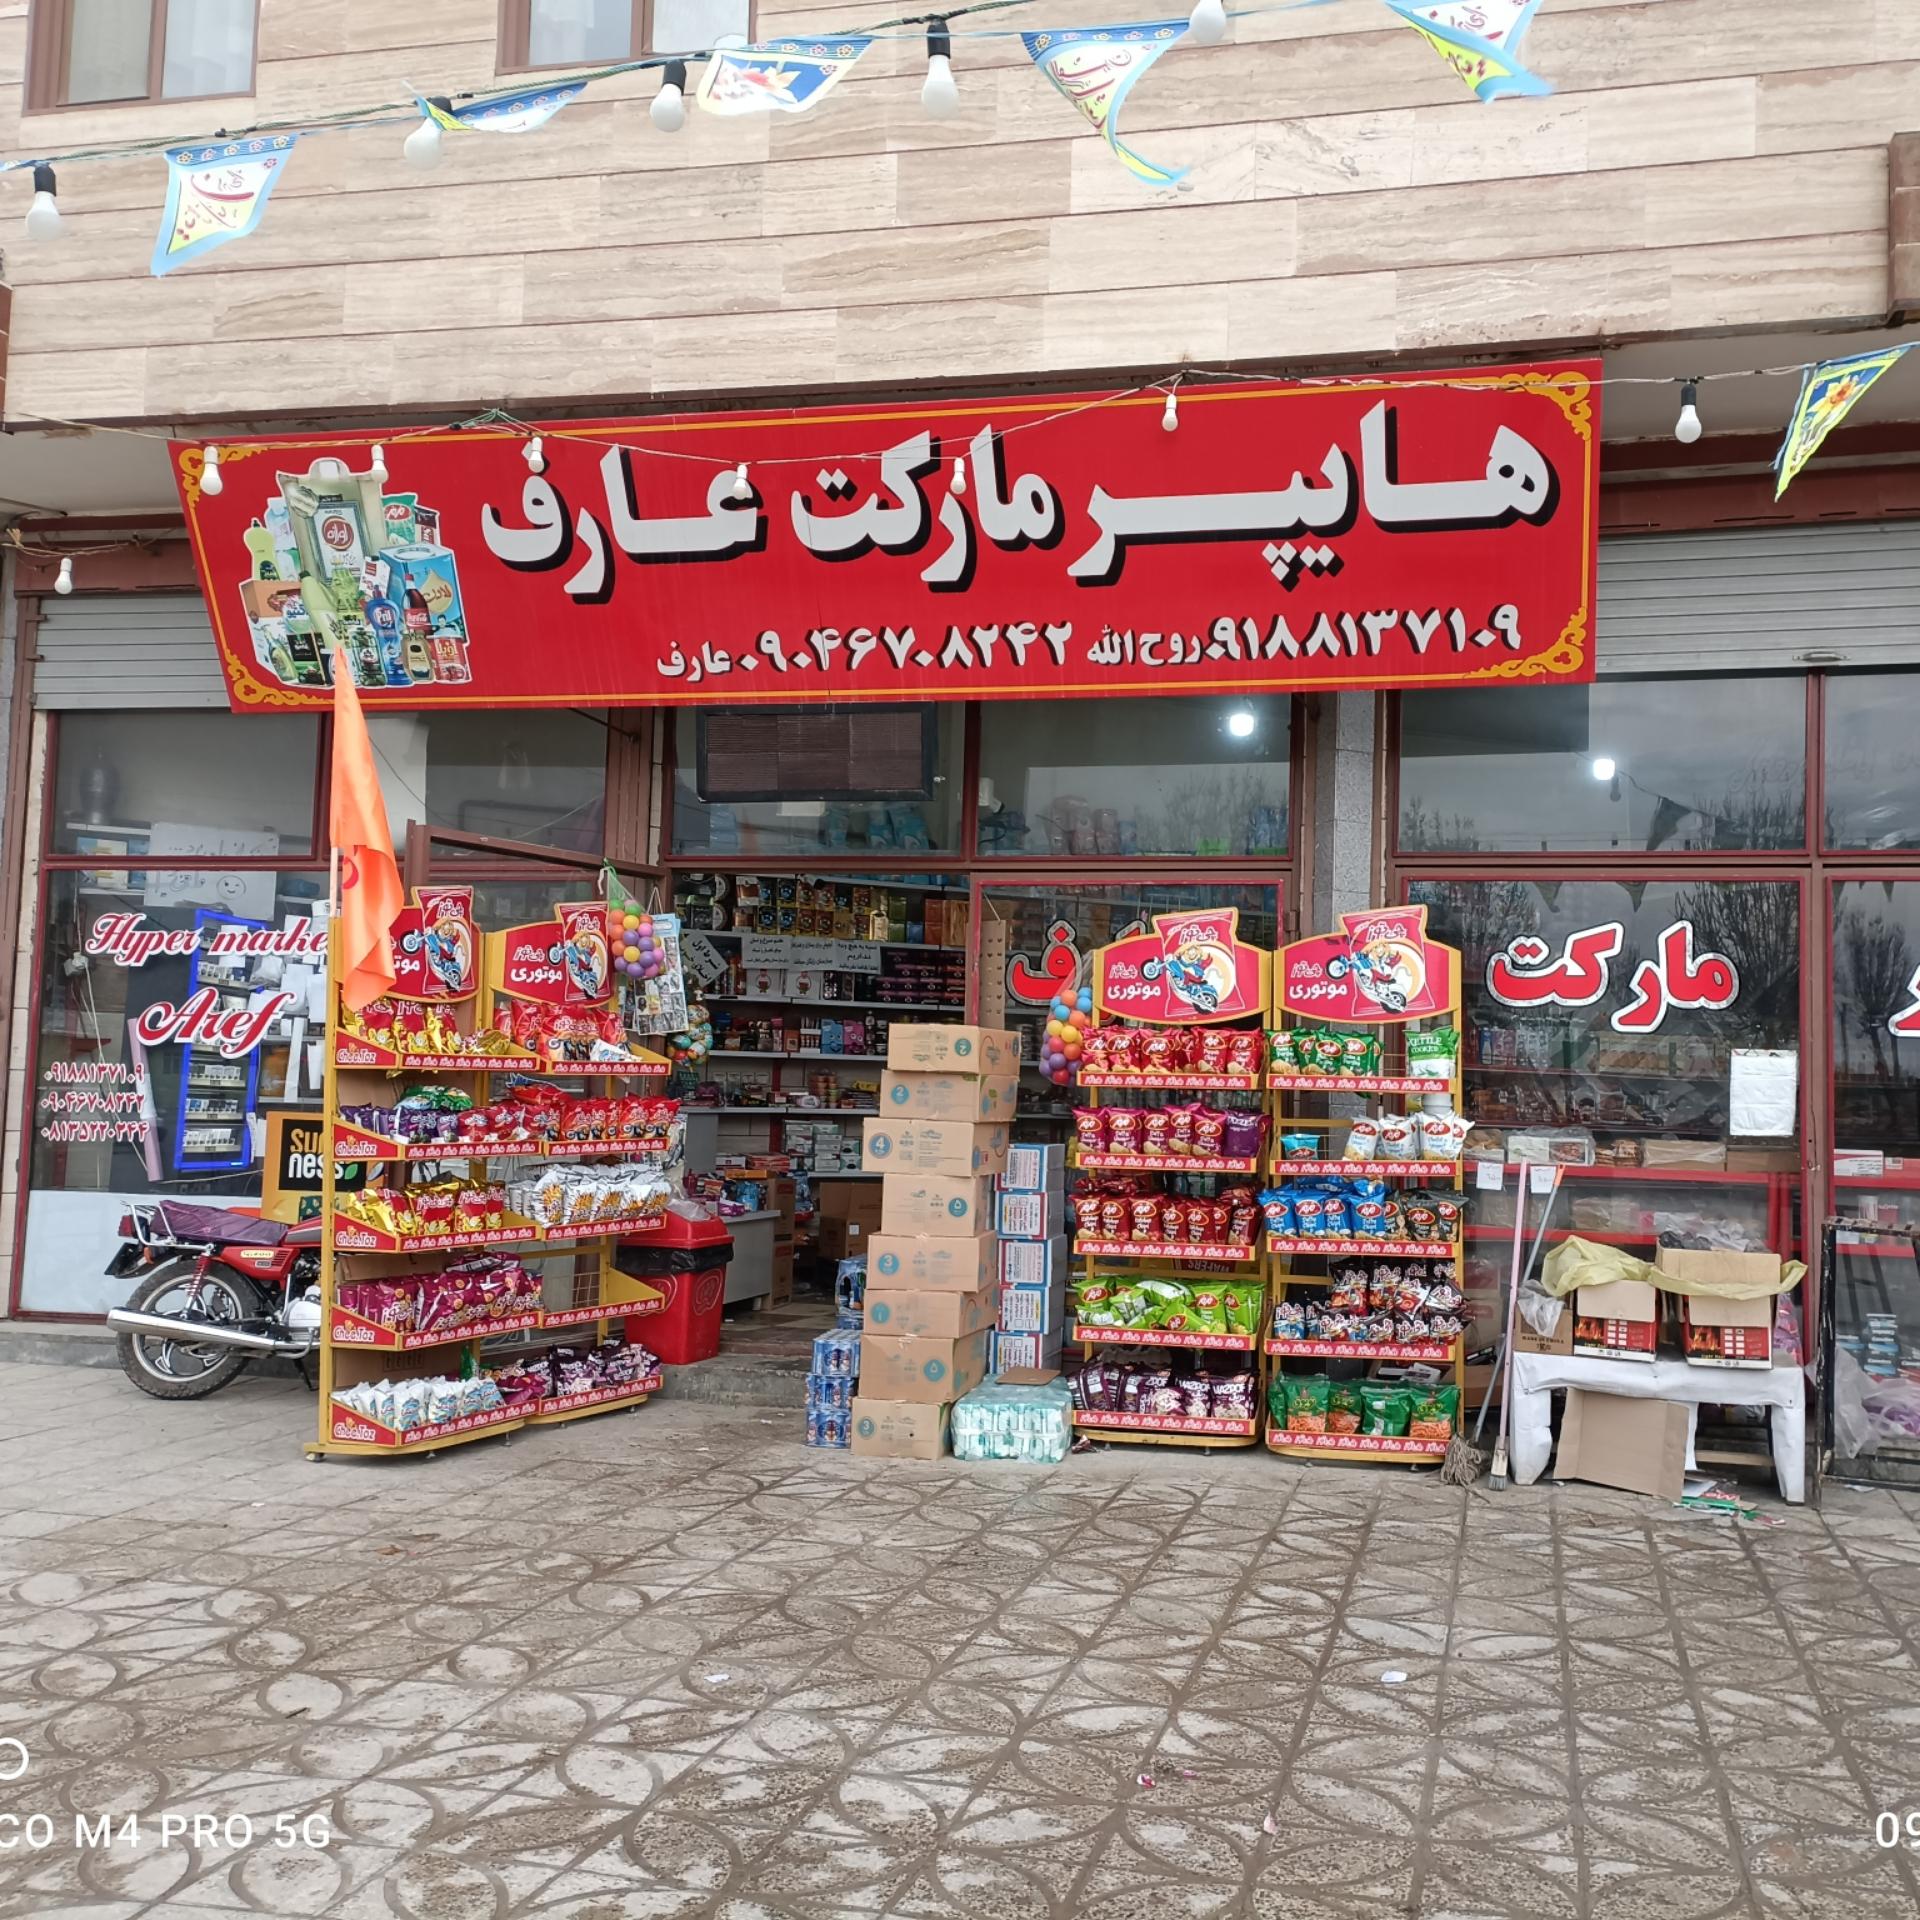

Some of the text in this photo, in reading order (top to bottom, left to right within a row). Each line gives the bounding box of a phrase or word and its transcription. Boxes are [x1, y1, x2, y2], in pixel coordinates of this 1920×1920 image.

[481, 400, 1551, 594] هایپر مارکت عارف
[657, 640, 732, 682] عارف
[85, 913, 328, 966] Hyper marke
[510, 966, 563, 984] موتوری
[1107, 982, 1161, 1000] موتوری
[1289, 980, 1348, 1000] موتوری
[1485, 919, 1741, 1034] مارکت
[137, 986, 297, 1059] Aref
[290, 1128, 323, 1154] Su
